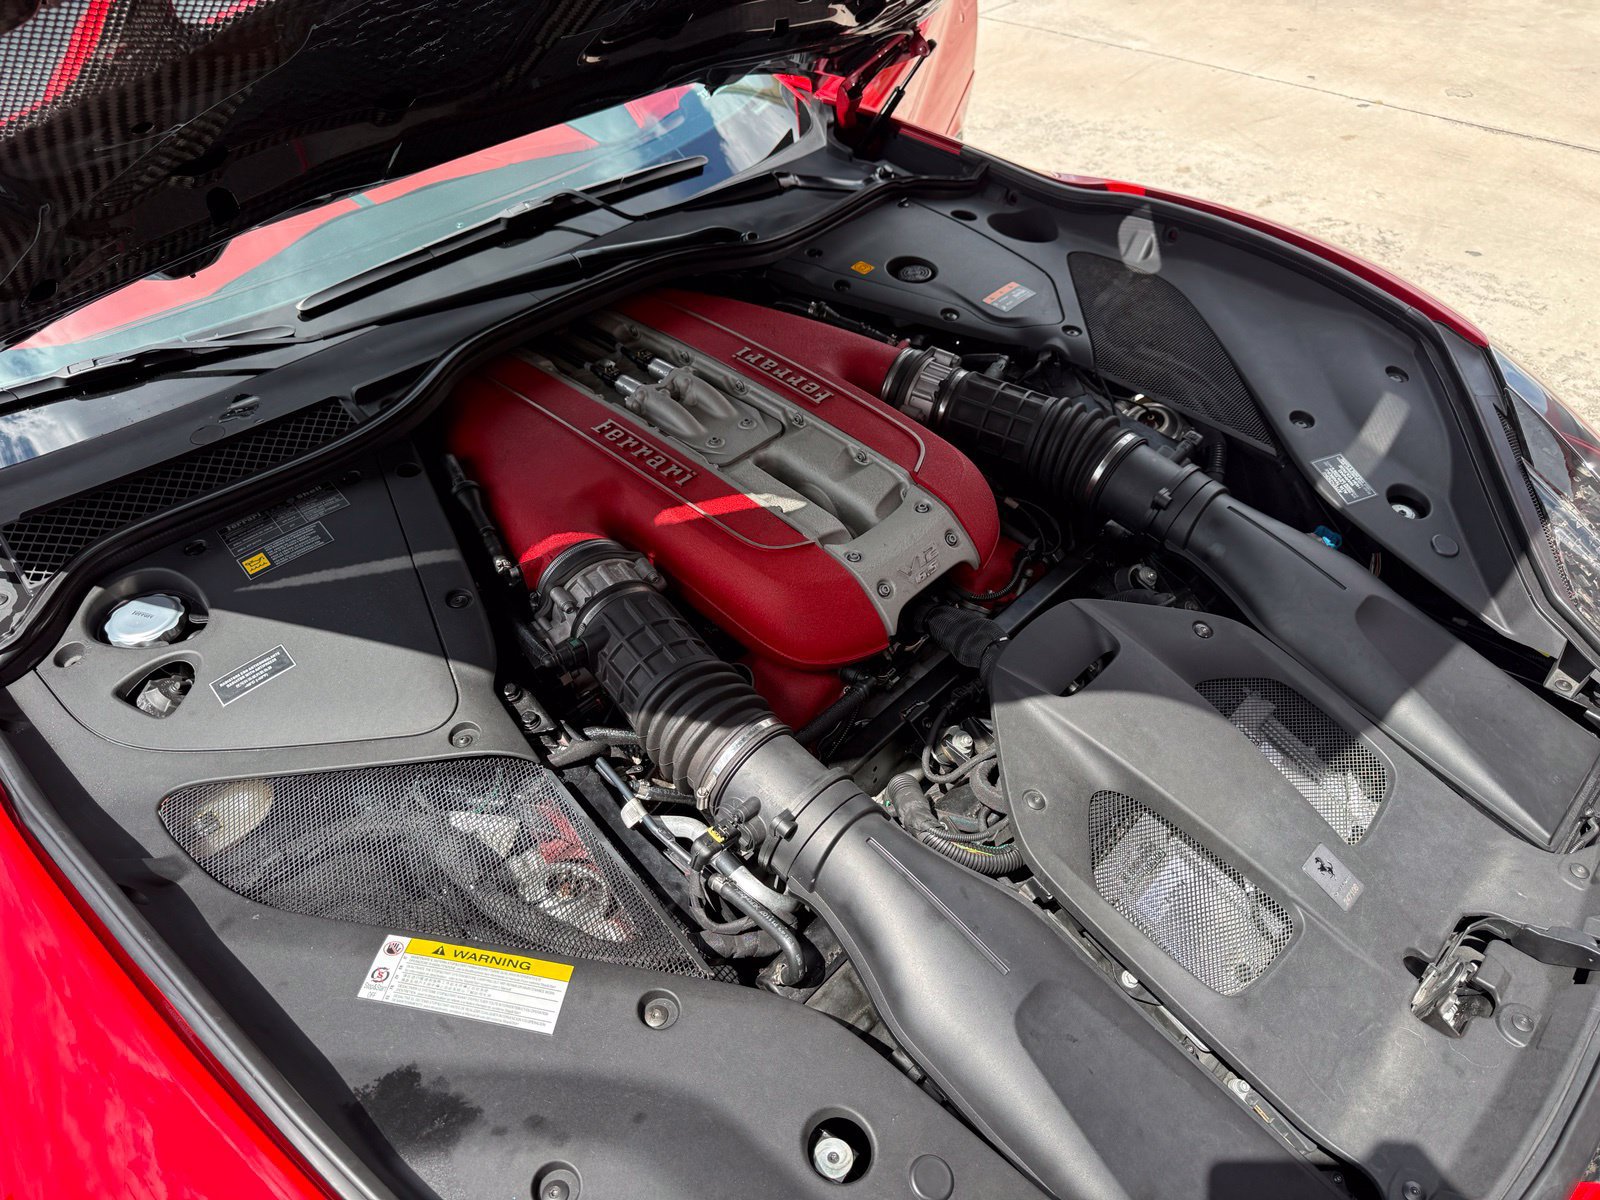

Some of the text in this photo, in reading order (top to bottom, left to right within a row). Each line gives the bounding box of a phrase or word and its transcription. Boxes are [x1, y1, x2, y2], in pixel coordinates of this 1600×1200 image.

[731, 346, 835, 404] Ferrari
[591, 418, 698, 487] Ferrari
[297, 485, 323, 500] Shell
[896, 545, 940, 577] V12
[453, 948, 532, 971] WARNING
